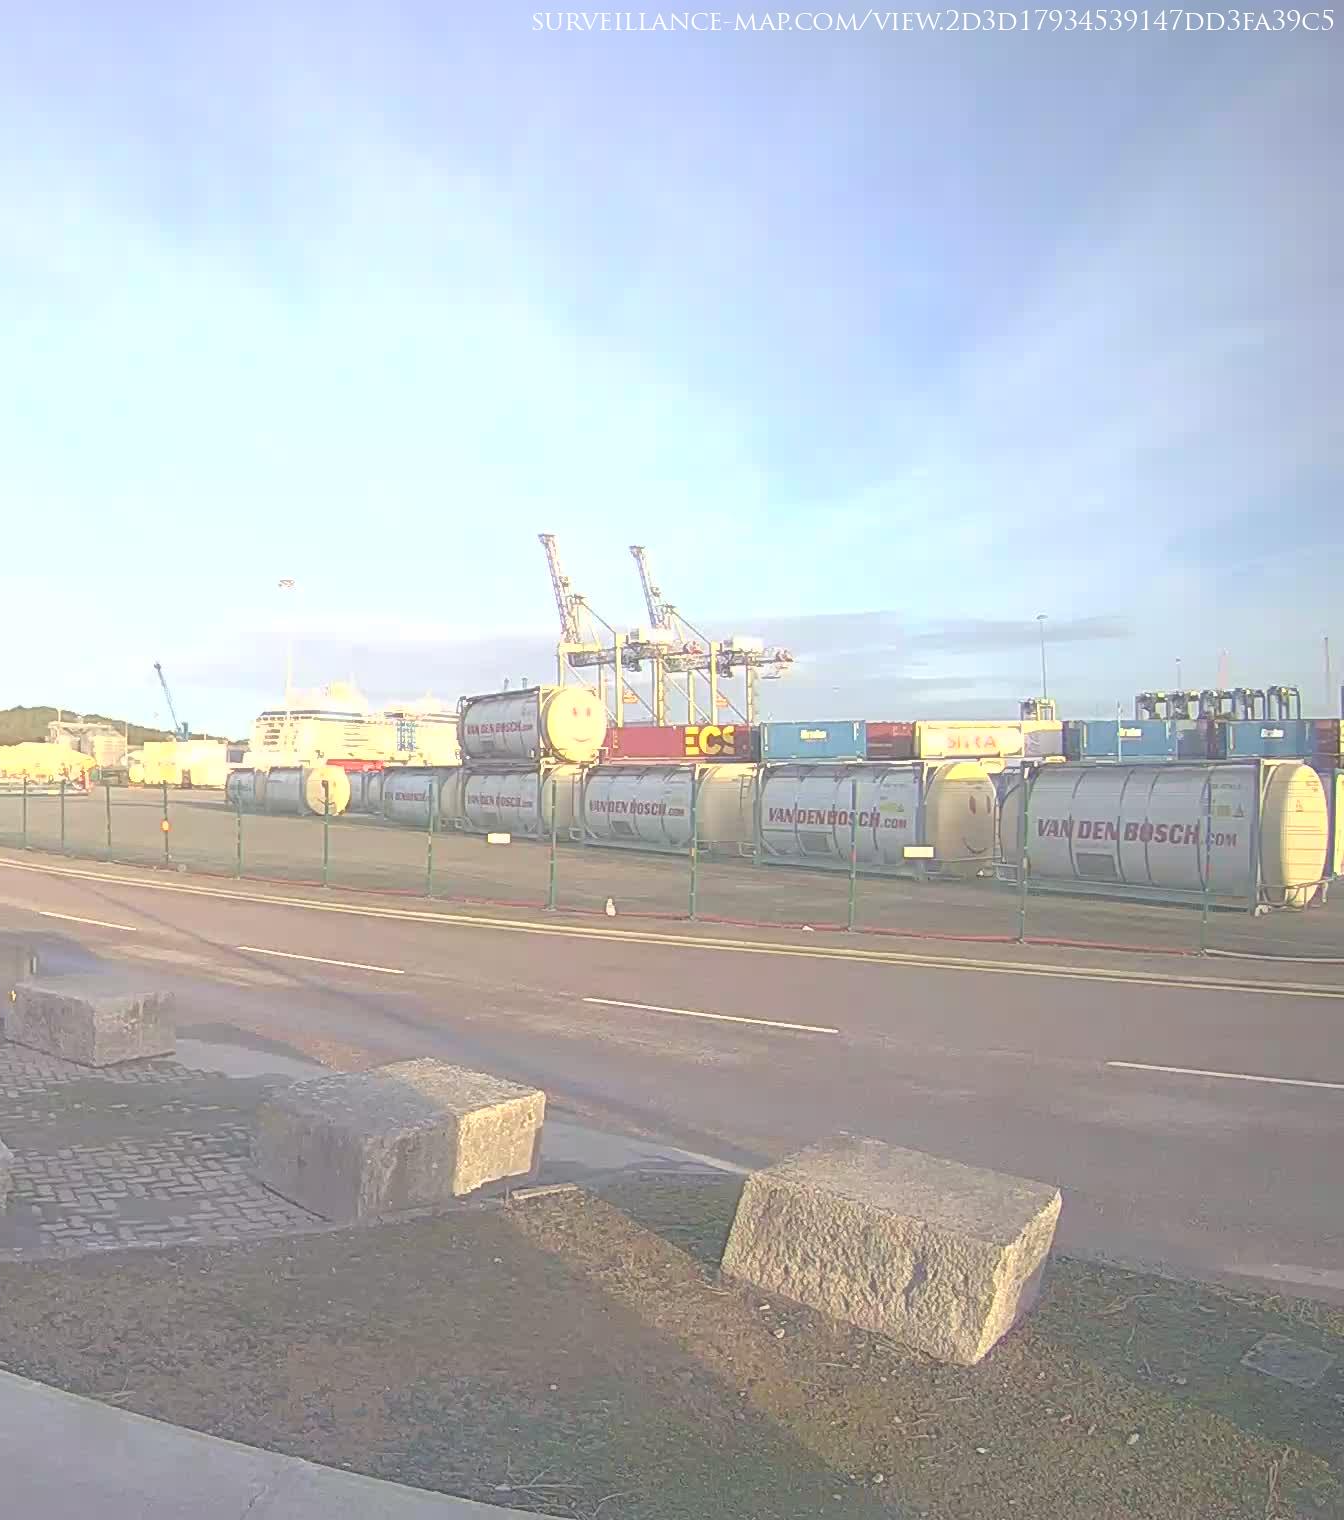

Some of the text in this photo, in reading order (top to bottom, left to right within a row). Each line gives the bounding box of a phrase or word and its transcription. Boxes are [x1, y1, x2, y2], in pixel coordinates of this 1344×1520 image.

[685, 725, 735, 756] ECS
[1038, 818, 1074, 838] VAN
[1078, 820, 1120, 841] DEN
